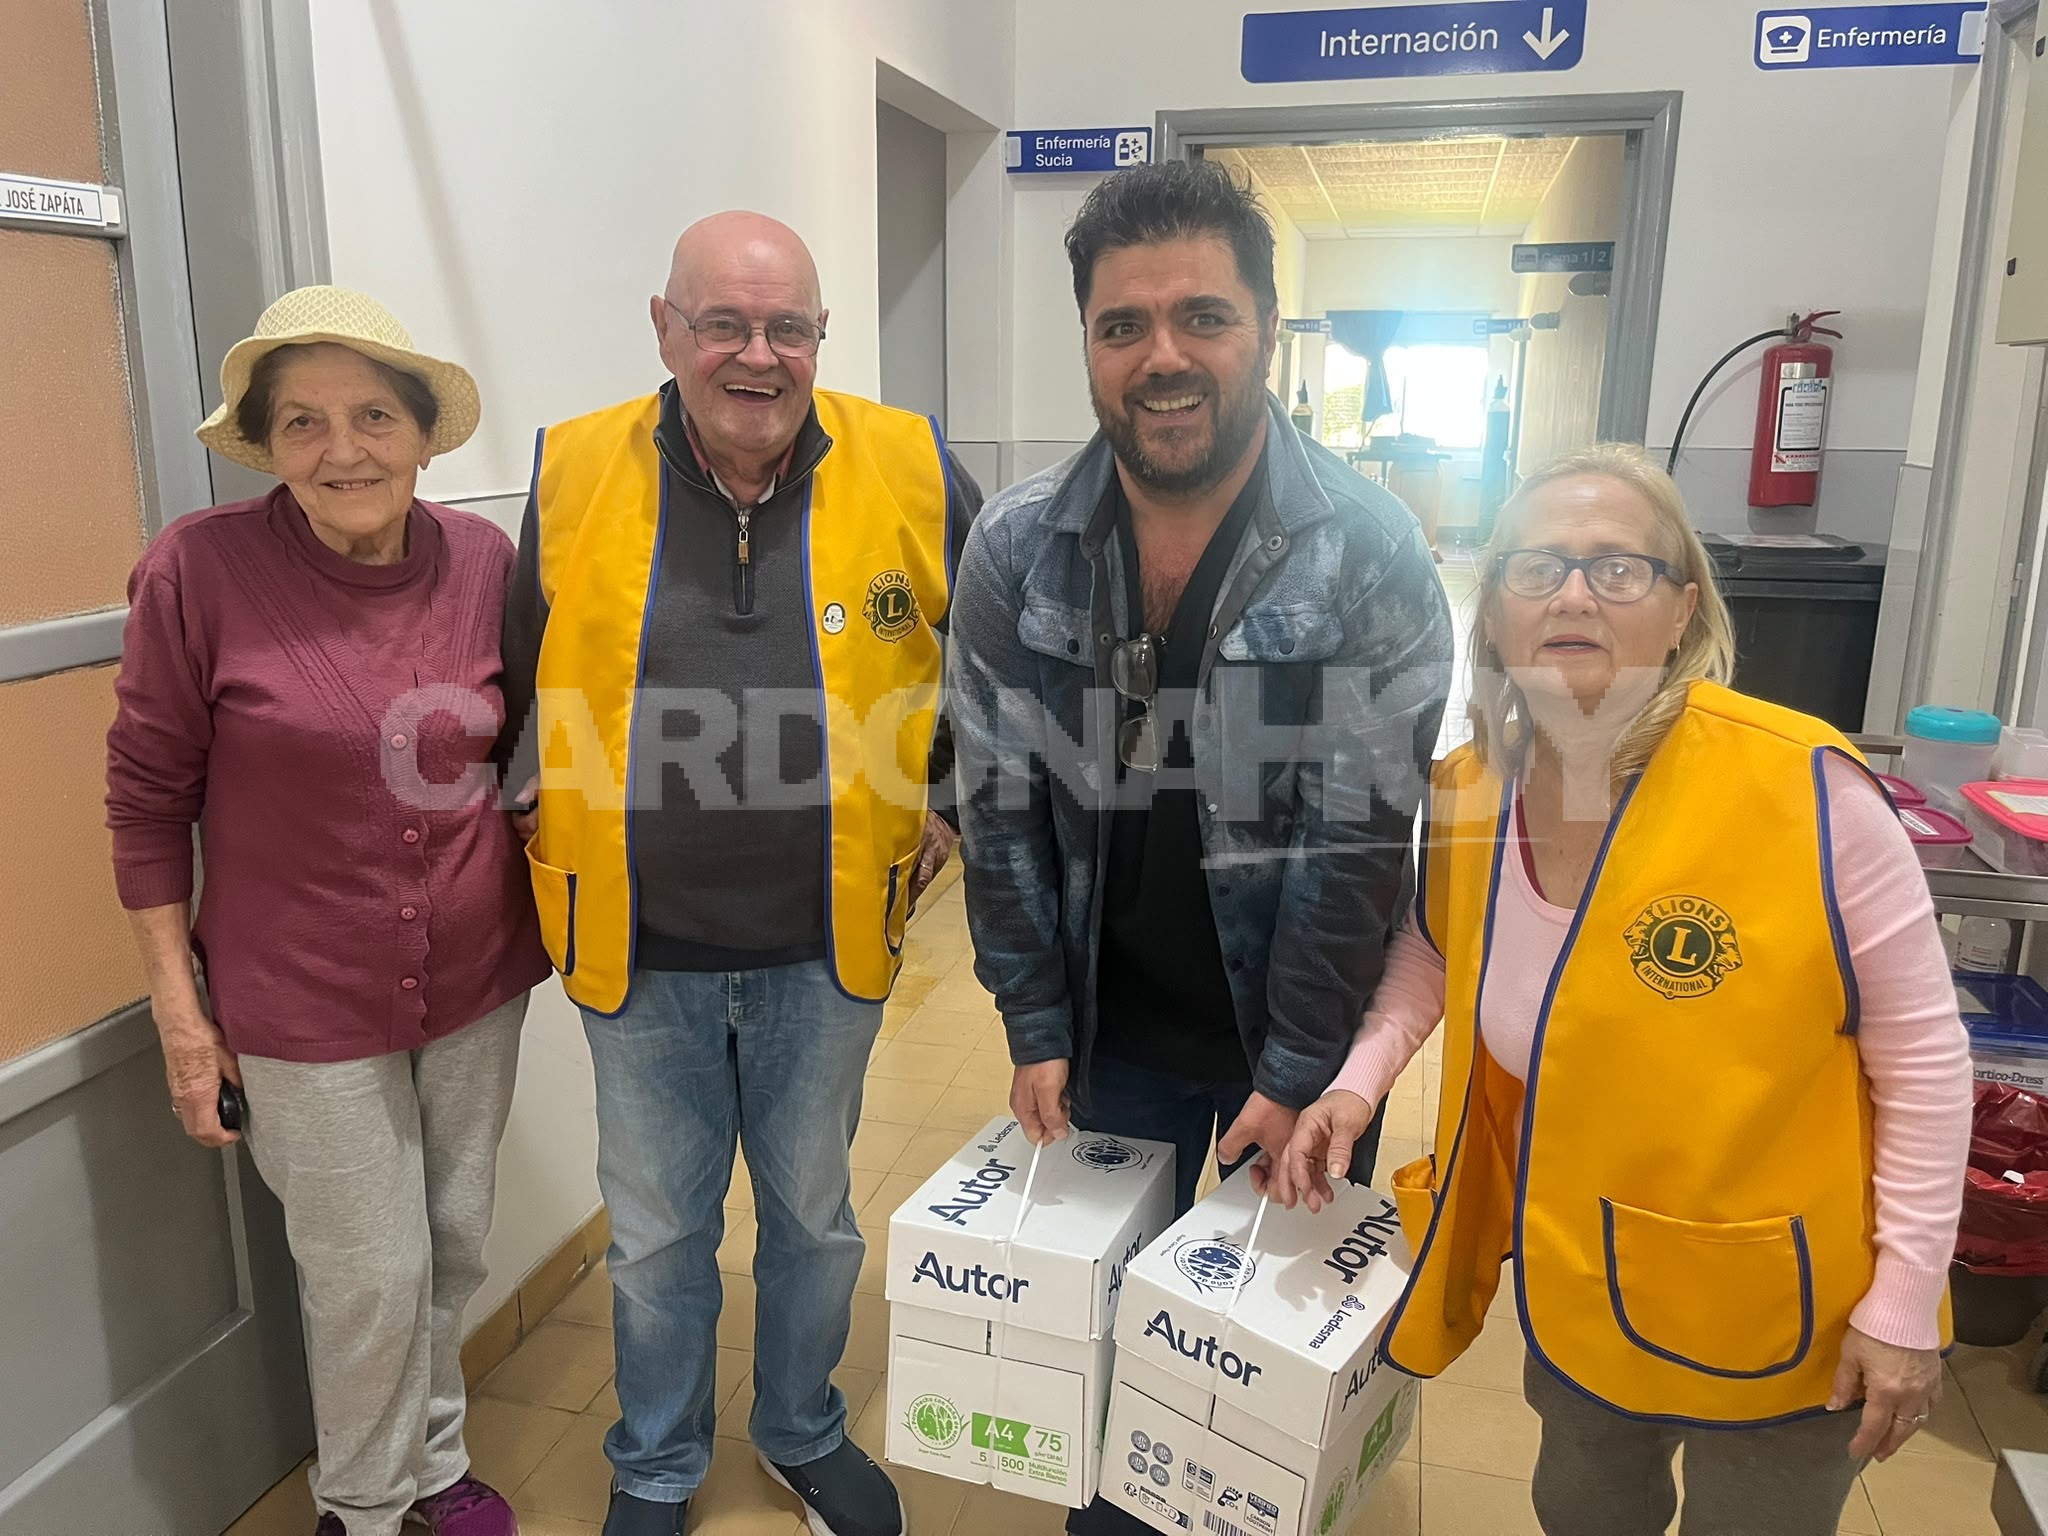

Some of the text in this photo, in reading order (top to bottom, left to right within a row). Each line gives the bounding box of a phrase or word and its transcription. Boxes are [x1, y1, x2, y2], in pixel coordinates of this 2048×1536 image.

[1320, 22, 1498, 57] Internación
[1817, 24, 1947, 48] Enfermería
[1035, 135, 1111, 150] Enfermería
[1035, 154, 1073, 167] Sucia
[6, 187, 85, 216] JOSÉ ZAPÁTA
[873, 573, 911, 591] LIONS
[887, 593, 903, 618] L
[1657, 899, 1726, 928] LIONS
[1666, 926, 1697, 966] L
[1641, 965, 1708, 992] INTERNATIONAL
[1973, 1067, 2044, 1085] ortico-Dress
[928, 1158, 1016, 1226] Autor
[1324, 1199, 1401, 1285] Autor
[912, 1251, 1030, 1303] Autor
[1308, 1309, 1352, 1350] Ledesma
[1143, 1310, 1262, 1387] Autor
[984, 1419, 1014, 1441] A4
[1035, 1430, 1062, 1452] 75
[979, 1452, 987, 1462] 5
[1001, 1456, 1025, 1471] 500
